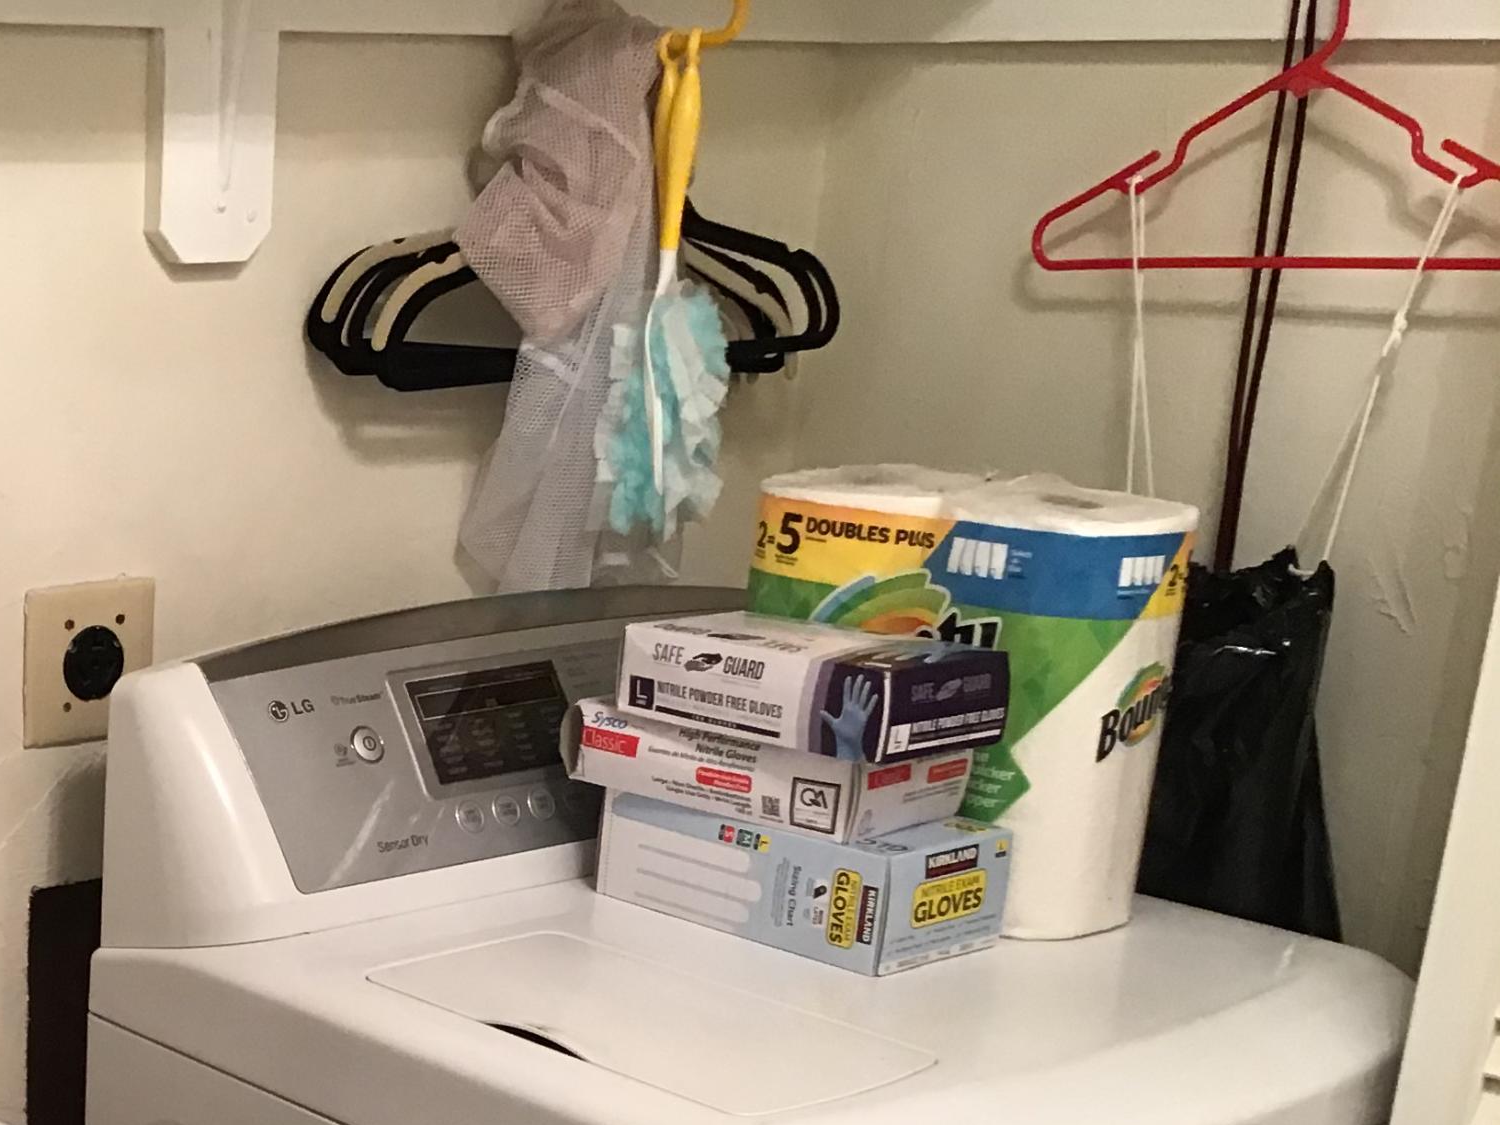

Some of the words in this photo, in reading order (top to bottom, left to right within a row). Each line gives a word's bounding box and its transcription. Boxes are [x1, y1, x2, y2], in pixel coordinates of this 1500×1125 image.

[805, 517, 890, 543] DOUBLES
[895, 529, 935, 549] PLUS
[652, 643, 685, 665] SAFE
[723, 656, 765, 680] GUARD
[636, 679, 648, 699] L
[657, 680, 687, 699] NITRILE
[688, 686, 724, 707] POWDER
[725, 694, 747, 712] FREE
[749, 698, 783, 719] GLOVES
[911, 682, 935, 702] SAFE
[291, 699, 315, 715] LG
[591, 711, 628, 730] Sysco
[912, 719, 937, 734] NITRILE
[981, 707, 1005, 722] GLOVES
[583, 729, 627, 754] Classic
[678, 727, 701, 742] High
[702, 729, 761, 752] Performance
[695, 744, 725, 758] Nitrile
[725, 749, 758, 764] Gloves
[377, 838, 410, 854] Sensor
[411, 834, 430, 848] Dry
[928, 847, 977, 869] KIRKLAND
[788, 865, 802, 897] Sizing
[921, 880, 954, 897] NITRILE
[786, 898, 800, 926] Chart
[829, 871, 850, 944] GLOVES
[862, 889, 877, 942] KIRKLAND
[913, 887, 984, 923] GLOVES
